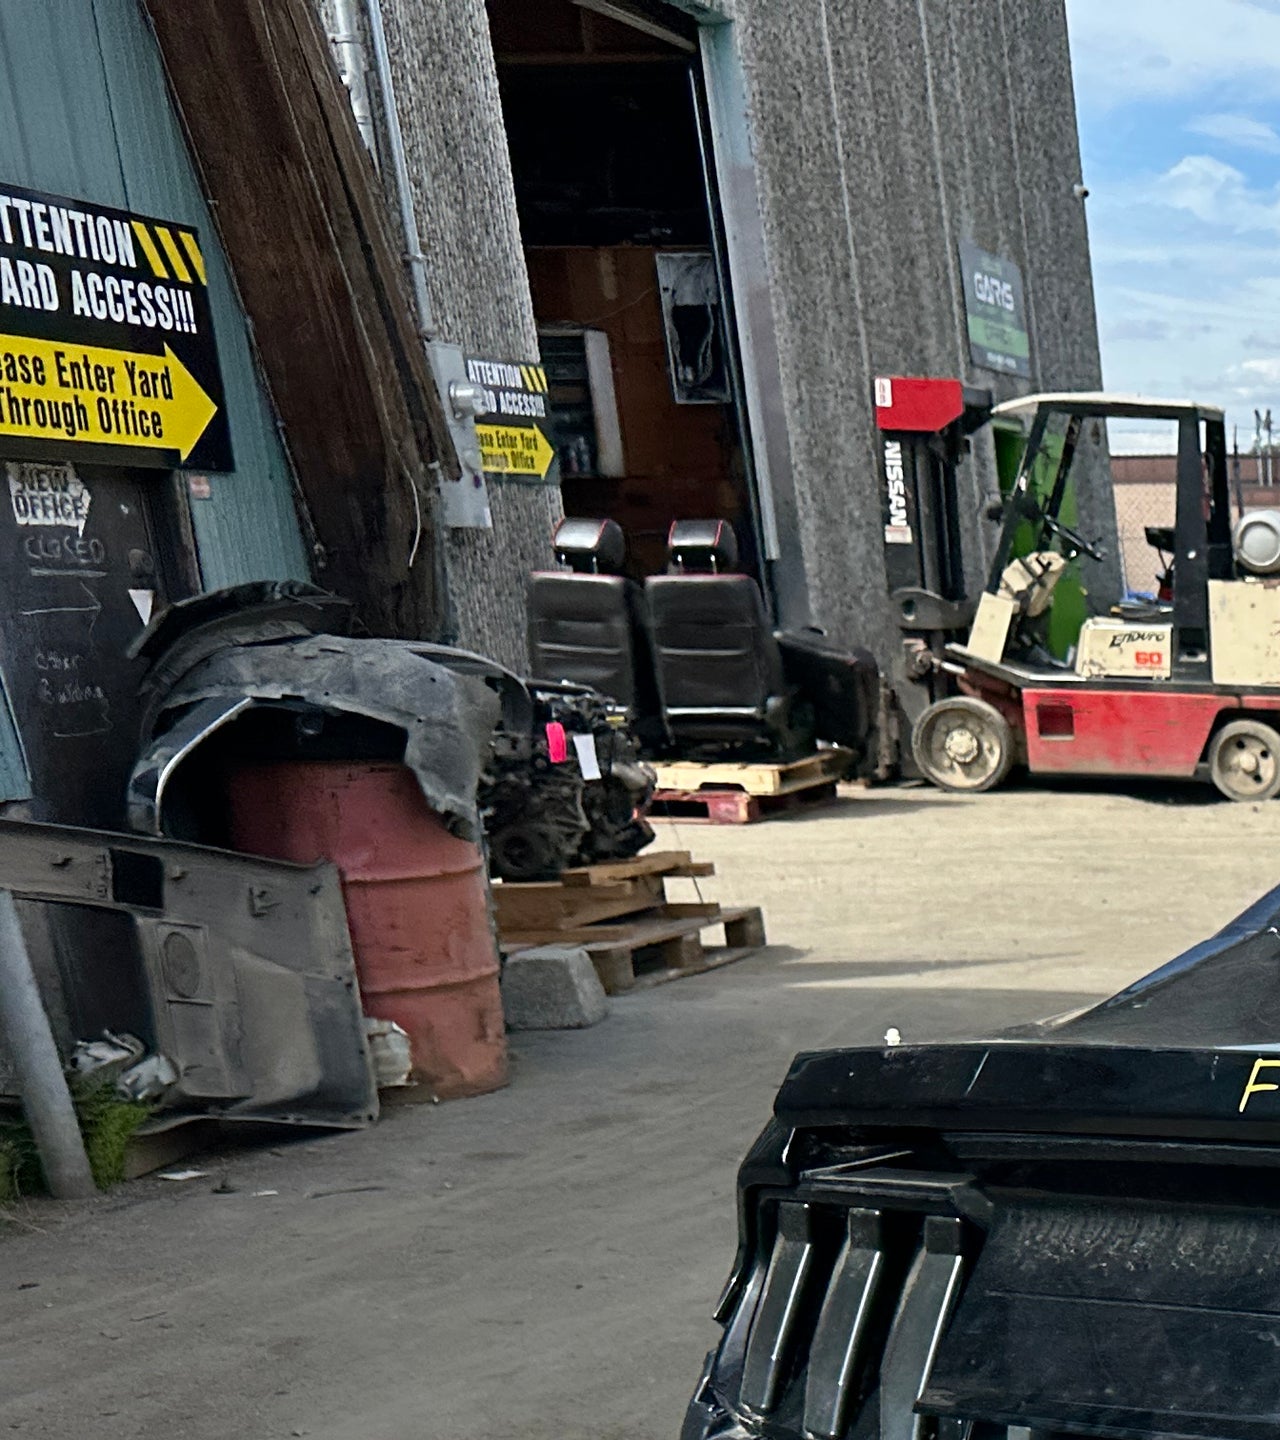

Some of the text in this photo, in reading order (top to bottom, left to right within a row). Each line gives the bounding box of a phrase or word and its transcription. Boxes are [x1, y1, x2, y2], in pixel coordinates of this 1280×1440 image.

[0, 195, 137, 268] TTENTION
[0, 257, 198, 334] ARD ACCESS!!!
[0, 351, 173, 400] ase Enter Yard
[467, 359, 523, 389] ATTENTION
[97, 397, 163, 439] Office
[14, 494, 86, 520] OFFICE
[884, 440, 908, 527] NISSAN
